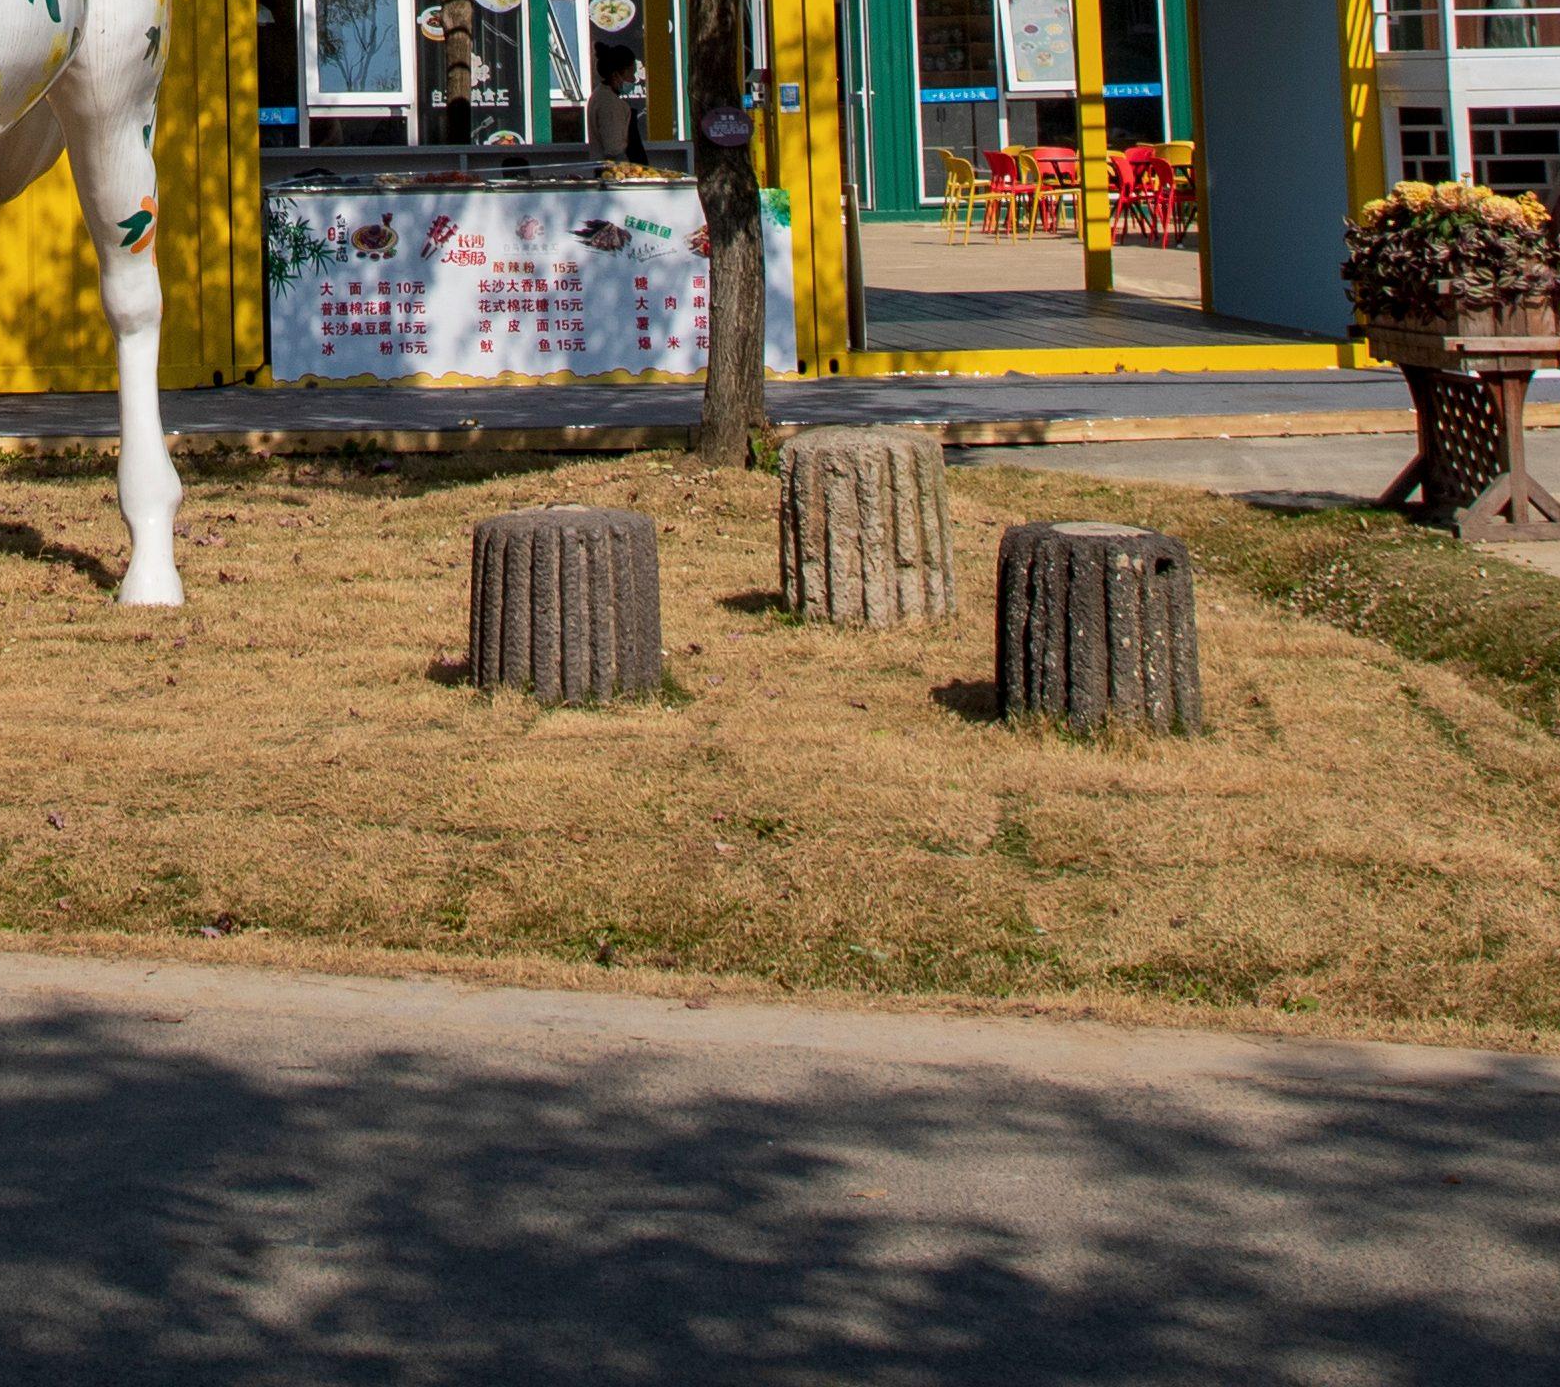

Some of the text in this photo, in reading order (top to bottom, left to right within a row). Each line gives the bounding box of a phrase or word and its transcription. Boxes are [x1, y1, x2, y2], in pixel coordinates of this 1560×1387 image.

[458, 234, 485, 249] 长沙
[441, 249, 487, 267] 大香肠
[493, 262, 579, 274] 酸辣粉 15元
[396, 281, 426, 295] 10元
[478, 279, 583, 293] 长沙大香肠 10元
[321, 301, 426, 317] 普通棉花糖 10元
[478, 299, 584, 313] 花式棉花糖 15元
[321, 322, 427, 336] 长沙臭豆腐 15元
[554, 319, 585, 333] 15元
[398, 342, 428, 355] 15元
[556, 339, 586, 352] 15元
